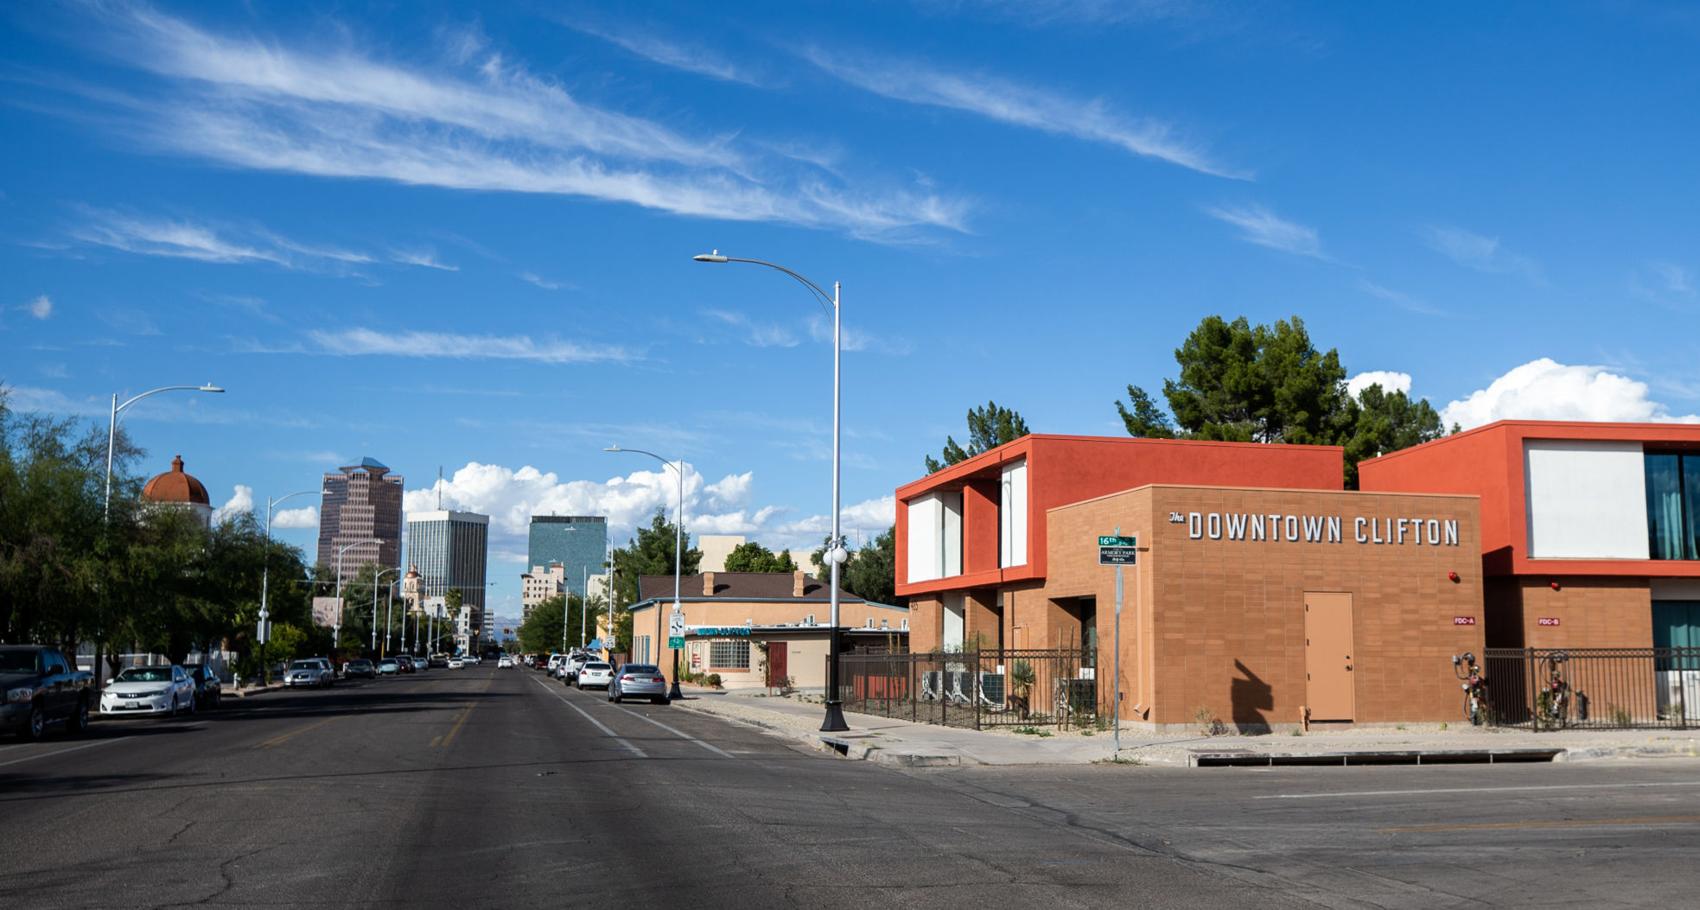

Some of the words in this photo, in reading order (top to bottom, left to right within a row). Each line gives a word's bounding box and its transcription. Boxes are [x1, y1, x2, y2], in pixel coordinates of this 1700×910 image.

[1169, 512, 1185, 522] The
[1189, 512, 1342, 543] DOWNTOWN
[1354, 517, 1459, 546] CLIFTON
[1100, 537, 1117, 545] 16th
